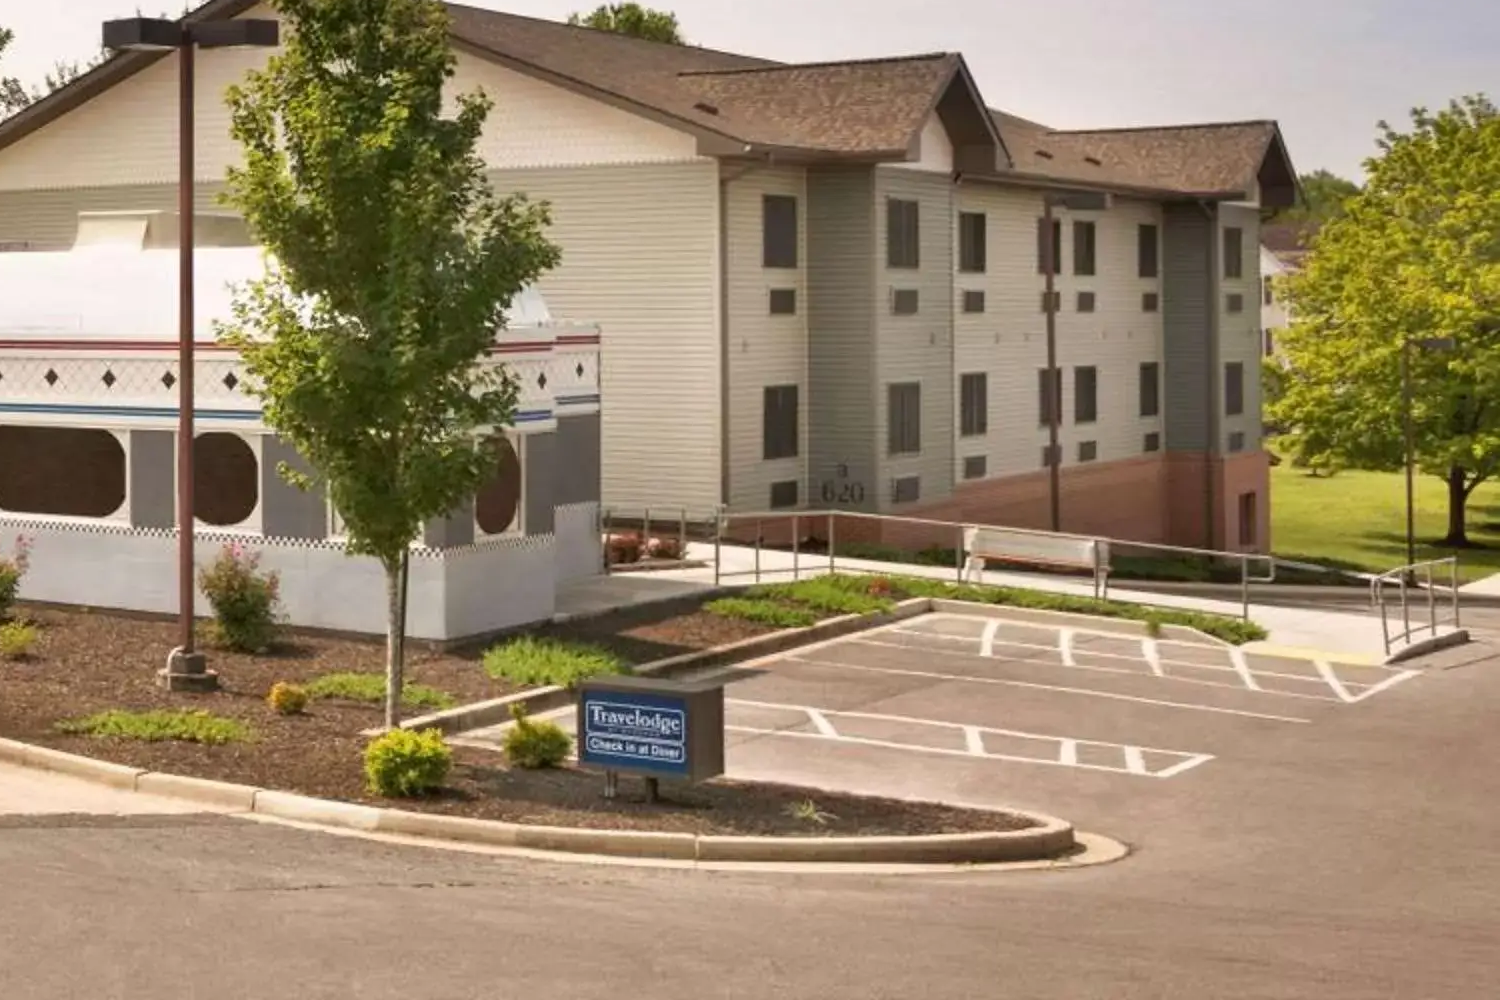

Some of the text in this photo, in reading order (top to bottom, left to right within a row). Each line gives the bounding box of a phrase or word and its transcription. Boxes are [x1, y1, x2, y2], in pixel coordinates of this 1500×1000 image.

[821, 480, 864, 504] 620
[589, 705, 681, 735] Travelodge
[589, 737, 623, 752] Check
